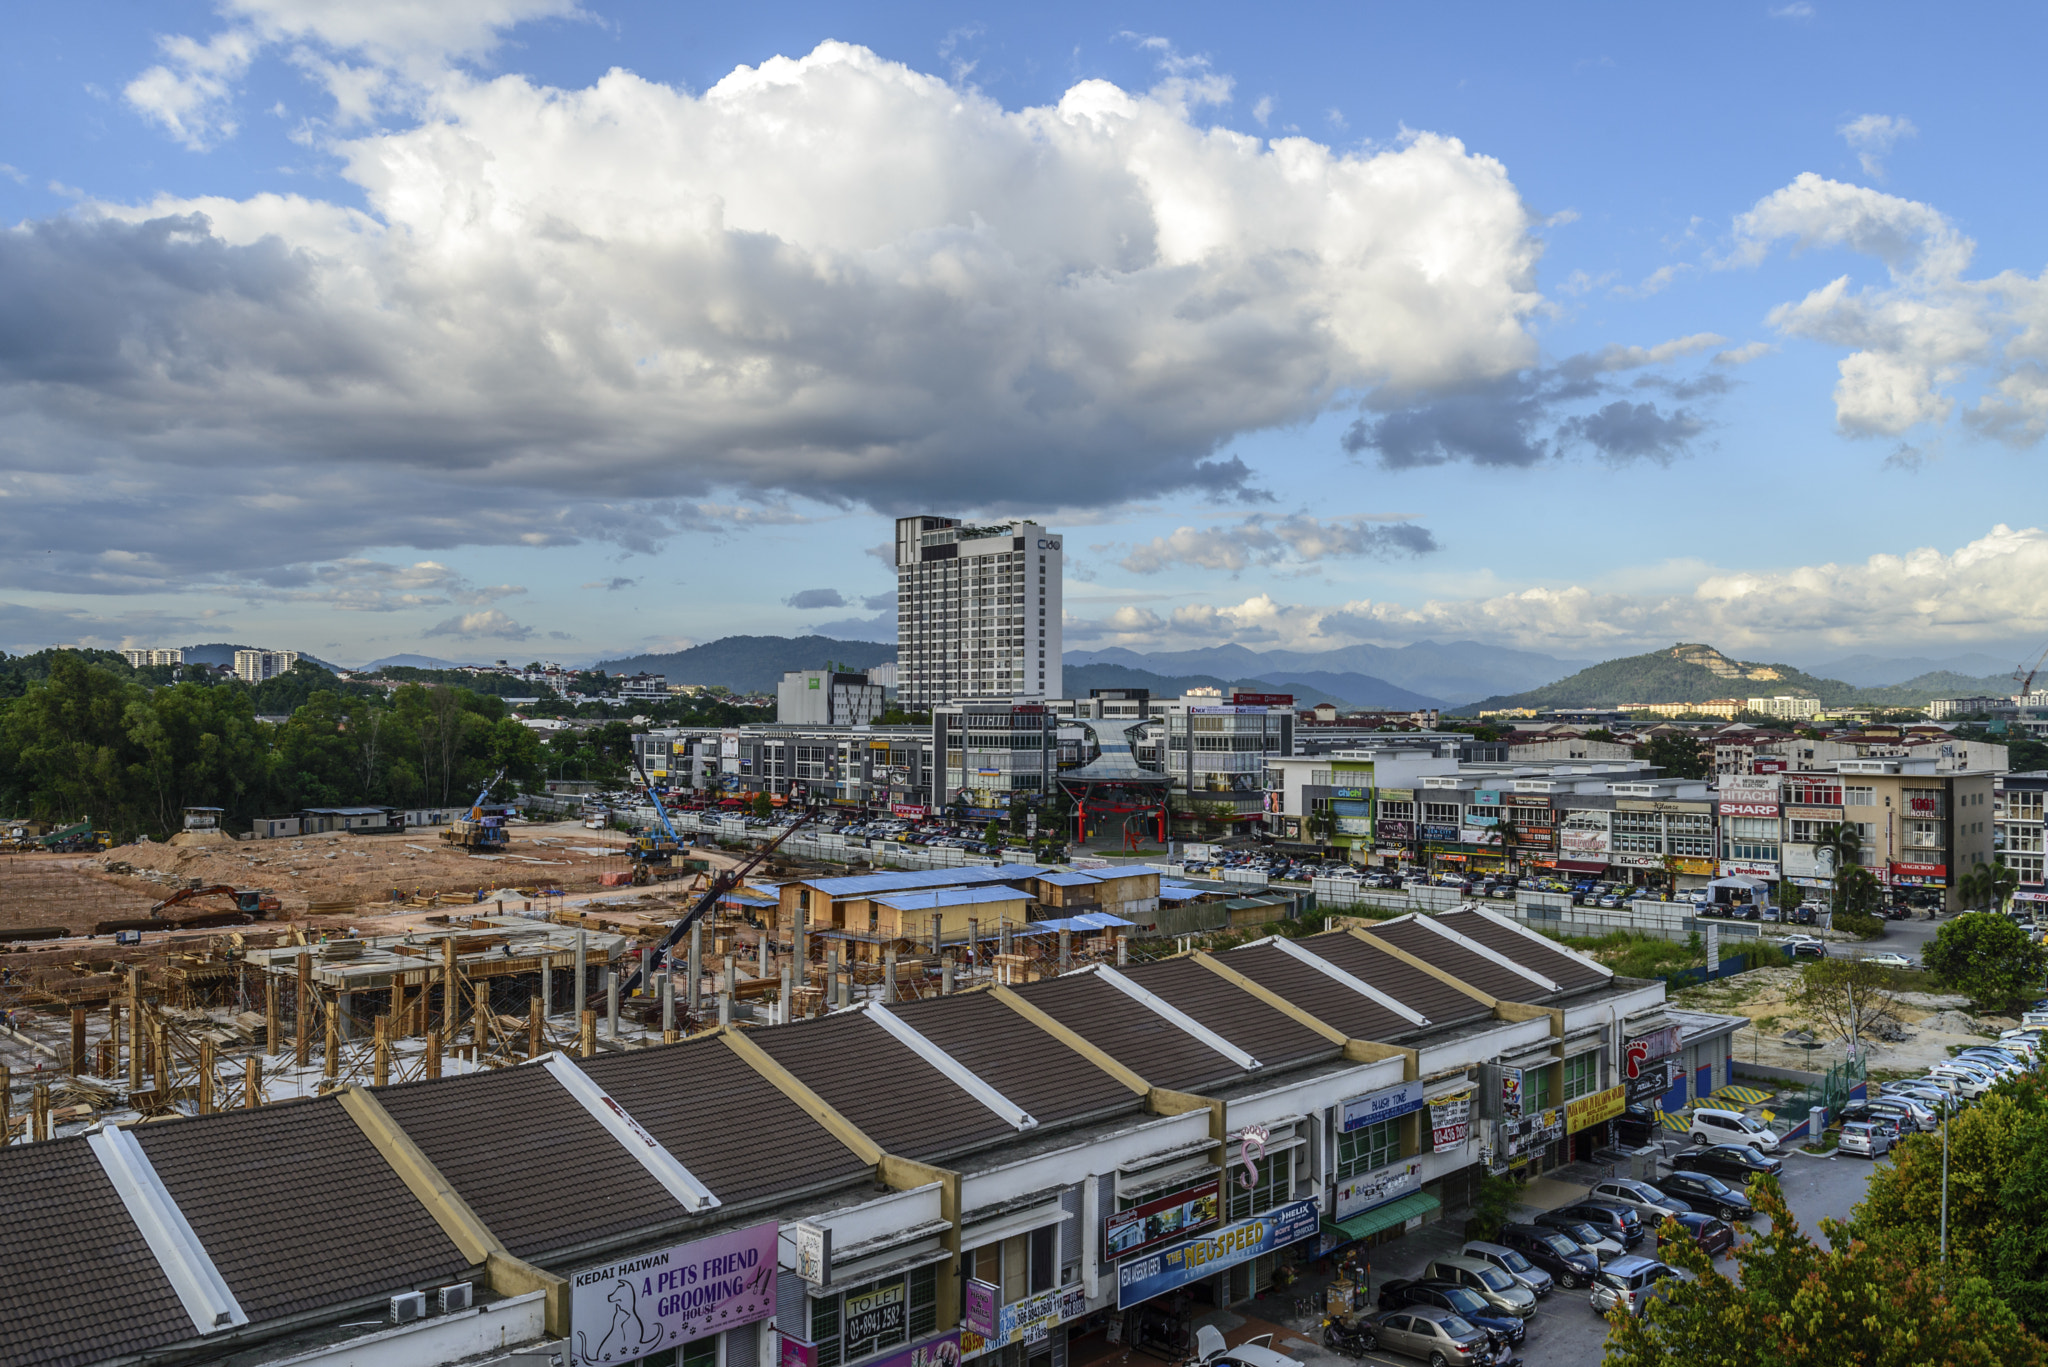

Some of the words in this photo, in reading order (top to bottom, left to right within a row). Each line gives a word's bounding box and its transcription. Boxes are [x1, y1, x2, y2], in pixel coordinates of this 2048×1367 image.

[1721, 790, 1776, 801] HITACHI
[1720, 804, 1777, 814] SHARP
[1910, 798, 1935, 810] 1001
[1620, 856, 1649, 865] HairCo
[1735, 867, 1770, 876] Brothers
[1502, 1078, 1519, 1093] Toy
[1371, 1096, 1390, 1112] BLUSH
[1392, 1091, 1407, 1105] TONE
[1285, 1203, 1309, 1219] HELIX
[1166, 1249, 1182, 1266] THE
[1184, 1221, 1264, 1270] NEUSPEED
[576, 1267, 615, 1287] KEDAI
[618, 1252, 669, 1276] HAIWAN
[641, 1277, 652, 1298] A
[658, 1264, 697, 1293] PETS
[703, 1248, 758, 1280] FRIEND
[658, 1276, 743, 1317] GROOMING
[850, 1297, 871, 1314] TO
[875, 1287, 900, 1306] LET
[971, 1290, 989, 1303] HAND
[682, 1302, 717, 1321] HOUSE
[970, 1304, 990, 1318] NAILS
[850, 1312, 880, 1340] 03-8941
[882, 1304, 900, 1328] 2582
